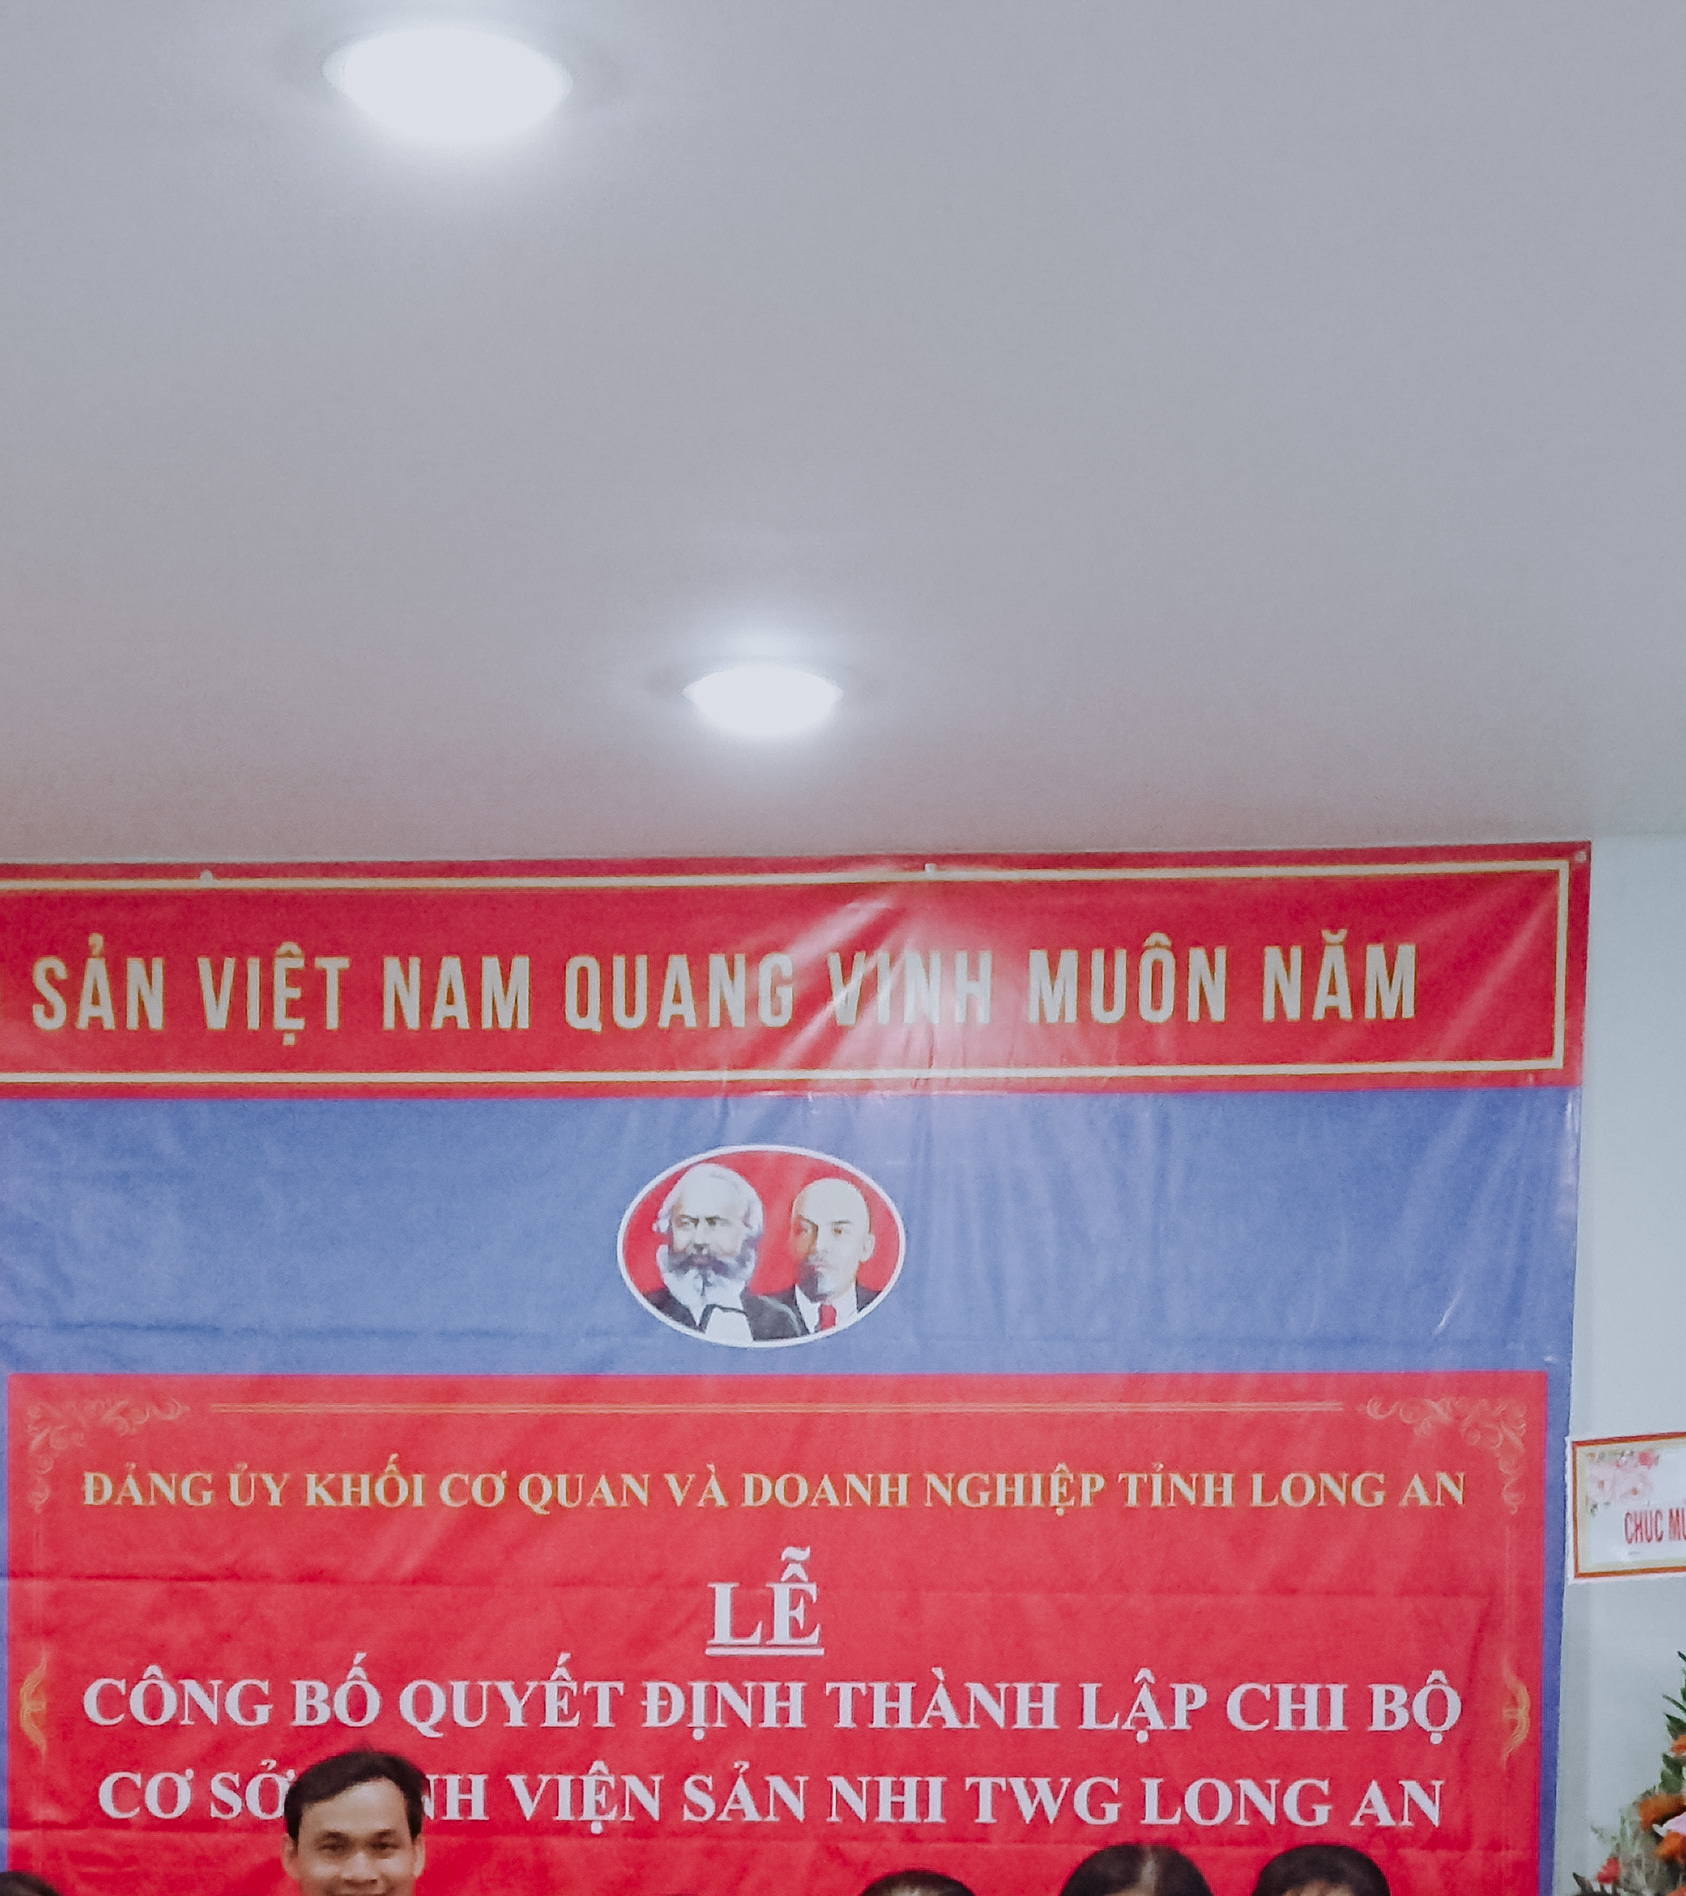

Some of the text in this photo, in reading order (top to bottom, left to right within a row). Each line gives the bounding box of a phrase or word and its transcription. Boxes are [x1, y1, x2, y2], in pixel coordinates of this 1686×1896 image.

[32, 933, 165, 1031] SẢN
[197, 941, 350, 1046] VIỆT
[383, 955, 532, 1030] NAM
[564, 953, 794, 1032] QUANG
[829, 949, 992, 1027] VINH
[1029, 932, 1229, 1025] MUÔN
[1263, 928, 1418, 1021] NĂM
[83, 1454, 1465, 1516] ĐẢNG ỦY KHỐI CƠ QUAN VÀ DOANH NGHIỆP TỈNH LONG AN
[708, 1547, 823, 1655] LỄ
[83, 1653, 1463, 1744] CÔNG BỐ QUYẾT ĐỊNH THÀNH LẬP CHI BỘ
[98, 1769, 194, 1820] CƠ
[210, 1759, 297, 1820] SỞ
[507, 1761, 663, 1834] VIỆN
[682, 1760, 807, 1822] SẢN
[826, 1775, 946, 1823] NHI
[965, 1776, 1120, 1825] TWG
[1140, 1778, 1332, 1826] LONG
[1350, 1779, 1443, 1827] AN
